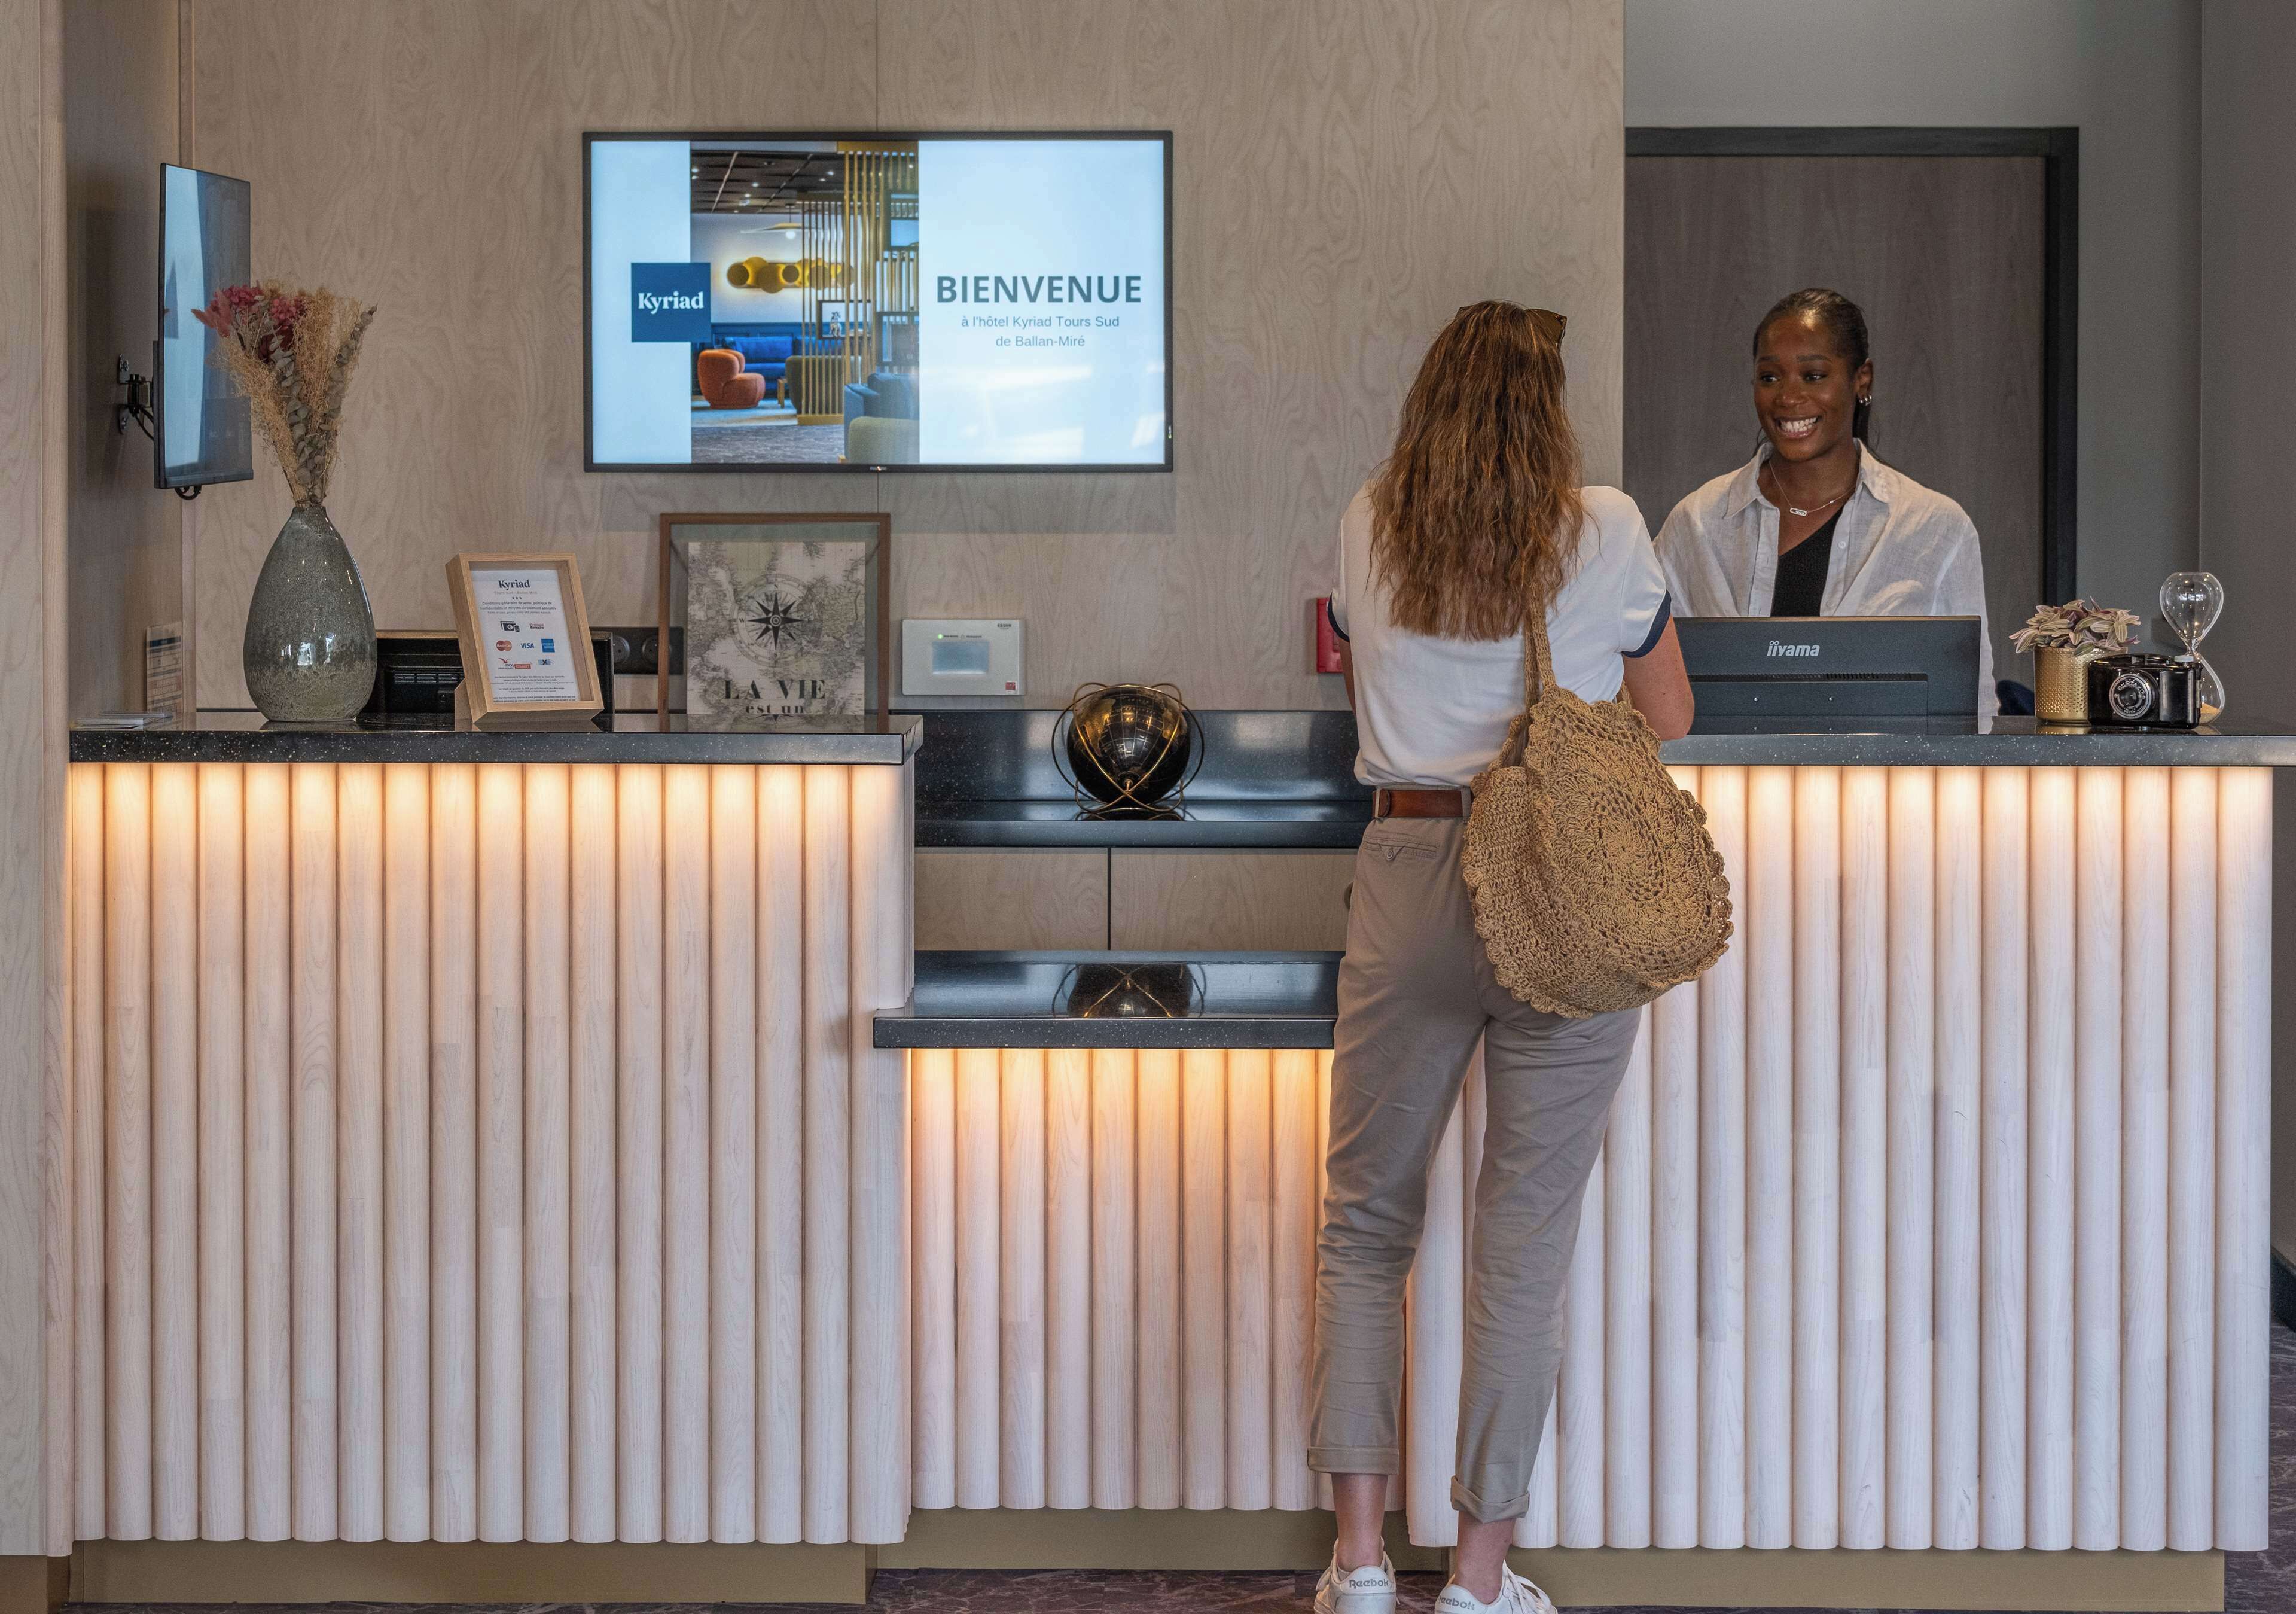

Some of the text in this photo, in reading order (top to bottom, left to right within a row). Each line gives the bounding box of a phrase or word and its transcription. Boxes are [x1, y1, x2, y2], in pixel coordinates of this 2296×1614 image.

[937, 276, 1141, 303] BIENVENUE
[638, 291, 704, 315] Kyriad
[961, 315, 1120, 330] à l'hôtel Kyriad Tours Sud
[996, 335, 1086, 347] de Ballan-Miré
[498, 579, 531, 590] Kyriad
[724, 680, 826, 699] LA VIE
[745, 705, 806, 714] est un
[1349, 1578, 1389, 1589] Reebok
